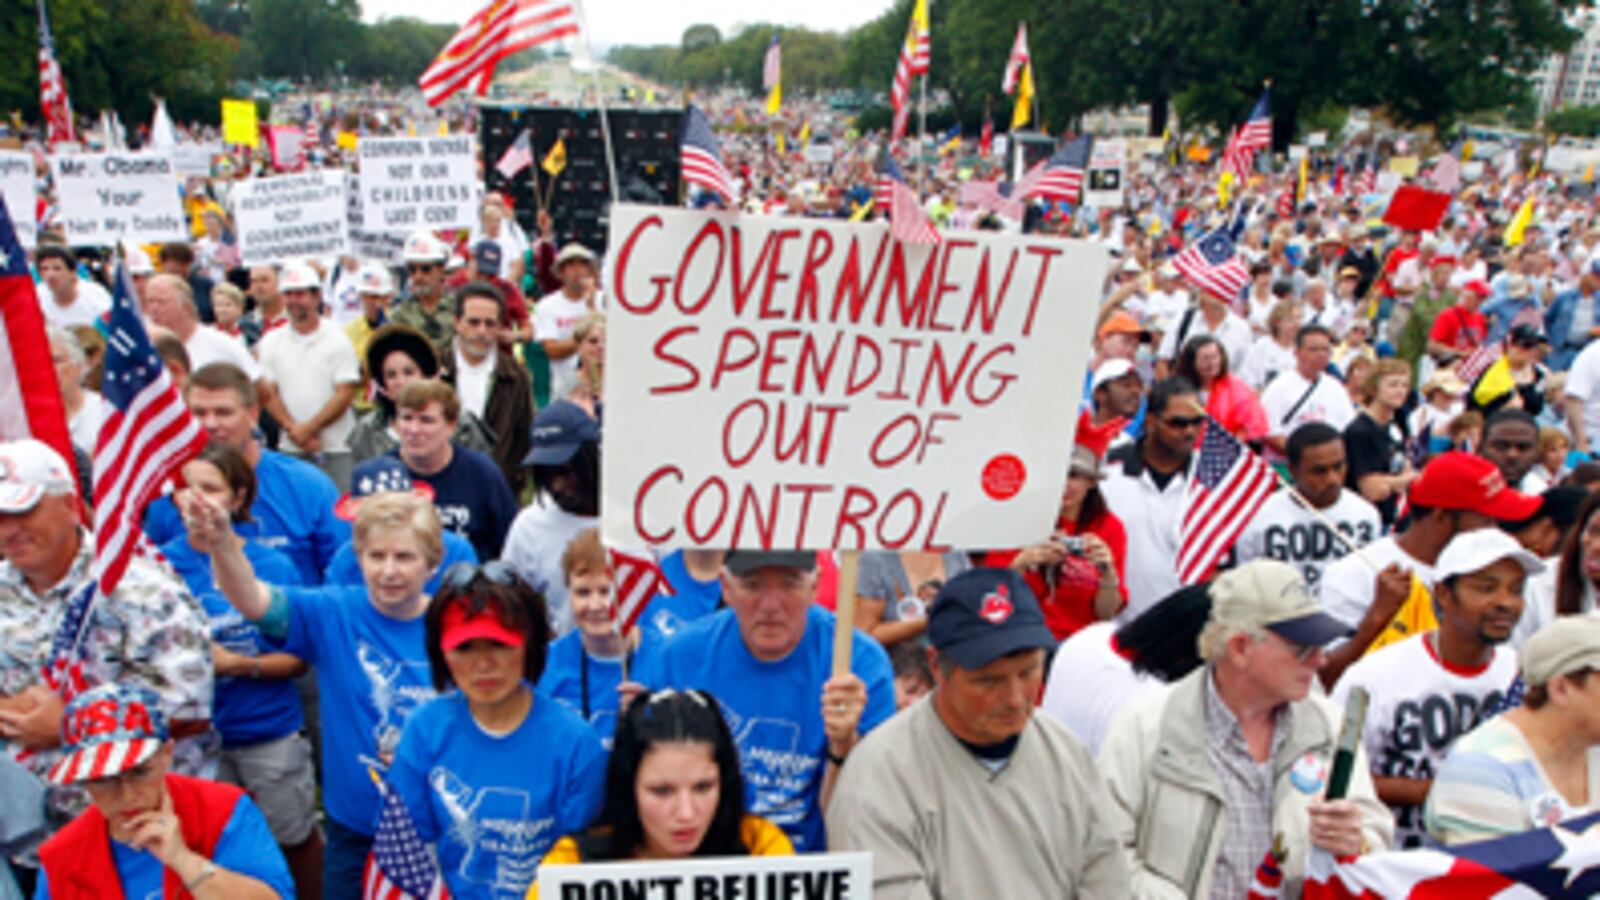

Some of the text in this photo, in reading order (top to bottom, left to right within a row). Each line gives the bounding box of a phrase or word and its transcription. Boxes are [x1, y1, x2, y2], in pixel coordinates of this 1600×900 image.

[104, 156, 170, 175] Obama
[387, 162, 448, 179] NOT OUR
[97, 188, 143, 206] Your
[370, 185, 470, 203] CHILDRENS
[104, 217, 126, 232] My
[133, 214, 179, 231] Daddy
[274, 208, 301, 222] NOT
[246, 220, 340, 246] GOVERNMENT
[613, 214, 1064, 336] GOVERNMENT
[650, 325, 1018, 407] SPENDING
[722, 398, 961, 468] OUT OF
[633, 465, 953, 551] CONTROL
[64, 699, 154, 744] USA
[694, 869, 850, 900] BELIEVE
